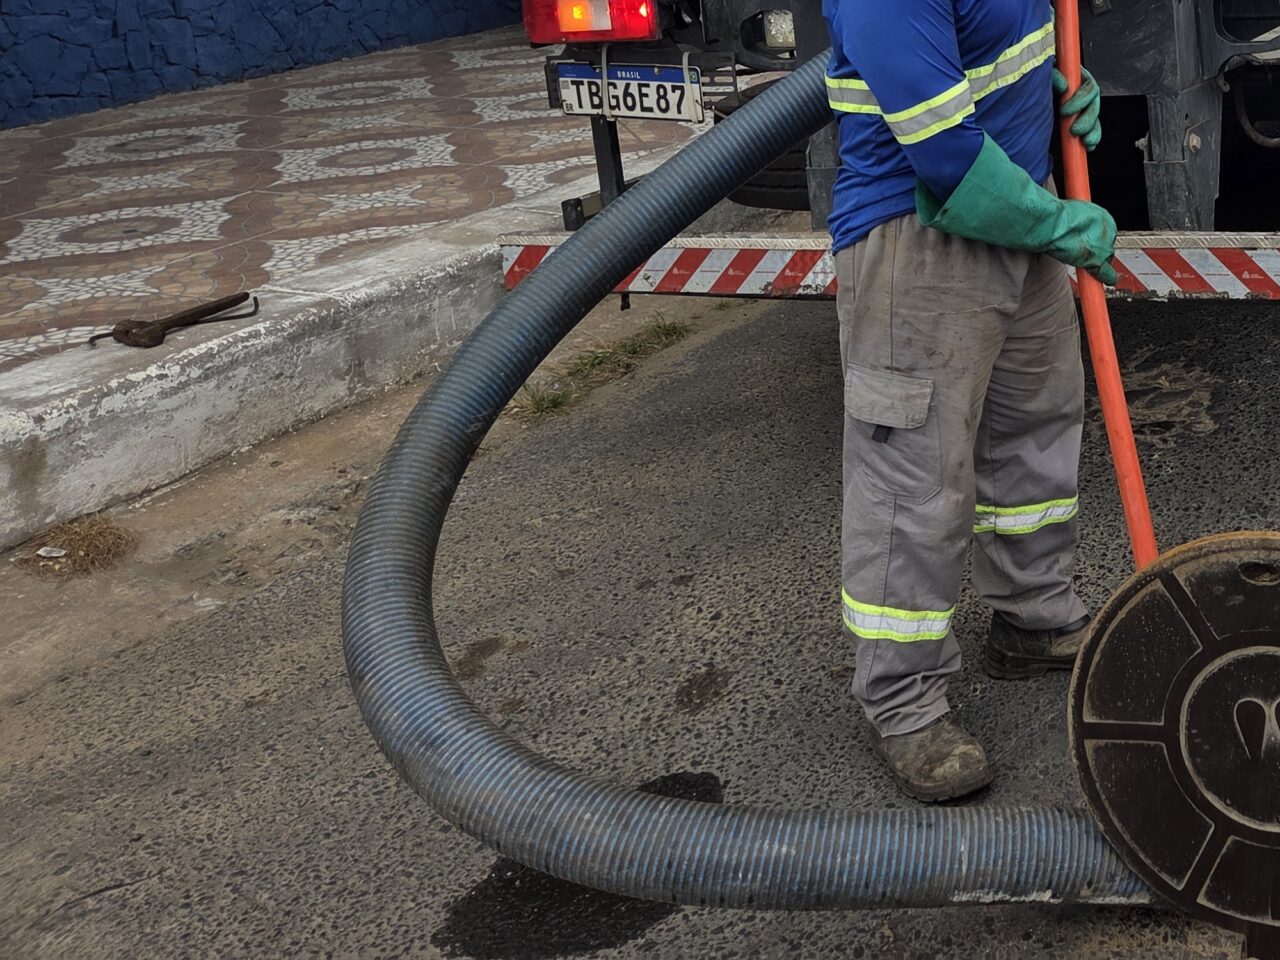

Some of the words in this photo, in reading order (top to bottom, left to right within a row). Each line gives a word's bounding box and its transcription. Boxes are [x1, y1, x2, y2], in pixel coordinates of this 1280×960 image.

[616, 70, 641, 79] BRASIL
[570, 80, 686, 115] TBG6E87
[565, 102, 575, 113] BR
